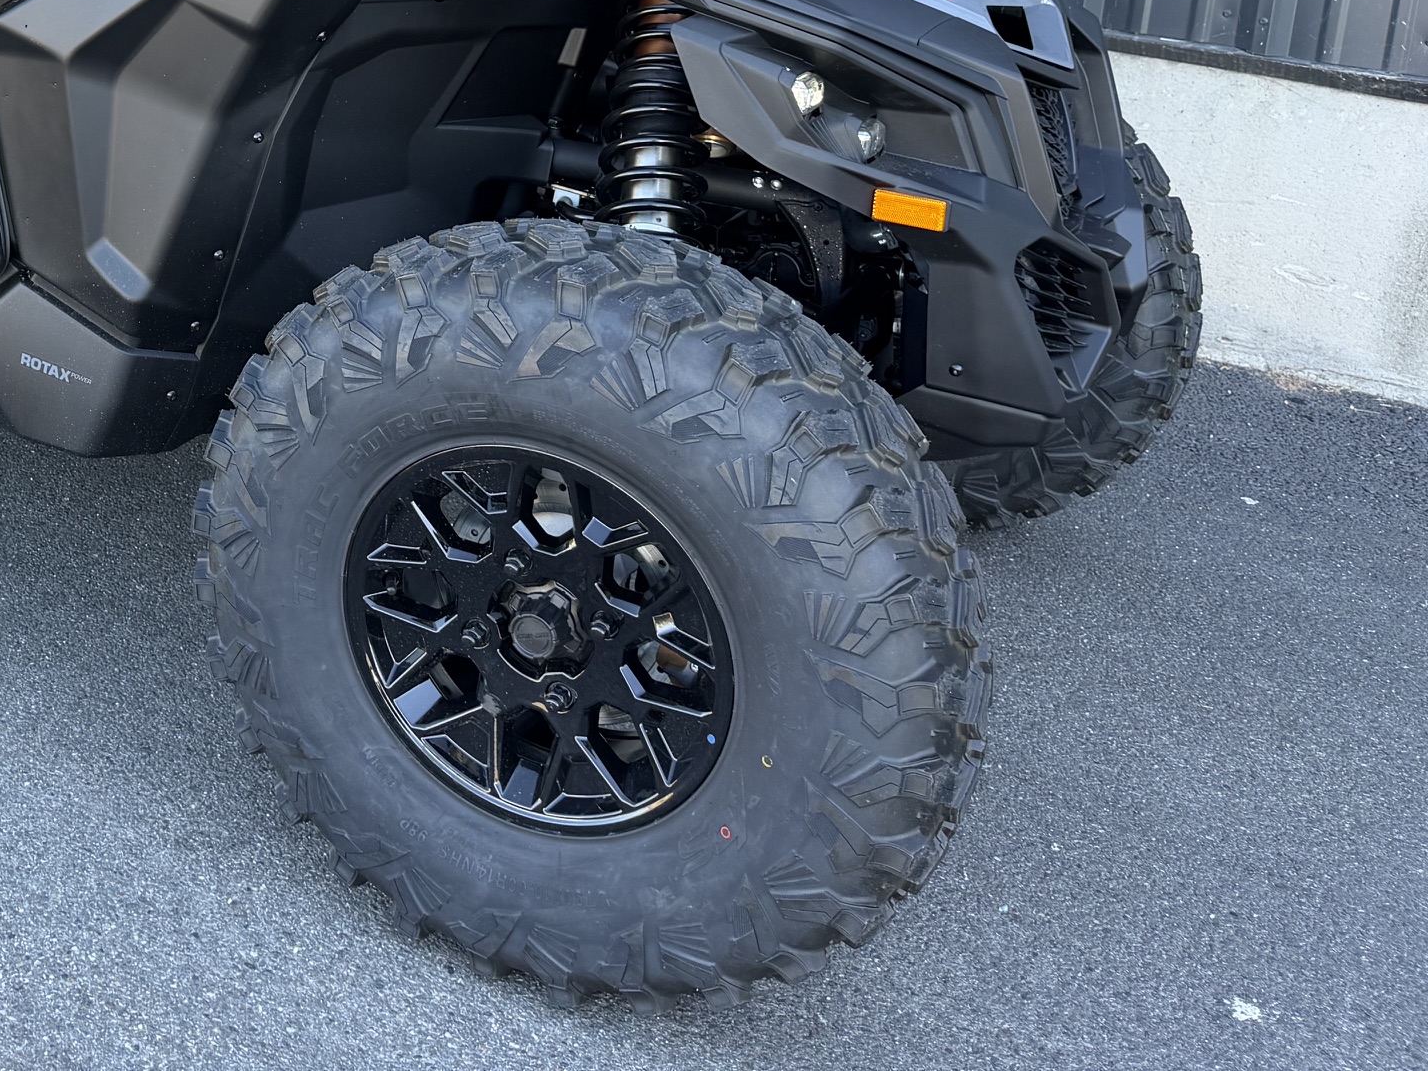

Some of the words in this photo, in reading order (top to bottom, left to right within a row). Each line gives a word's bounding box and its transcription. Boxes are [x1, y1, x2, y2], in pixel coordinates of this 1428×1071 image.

[20, 352, 71, 383] ROTAX
[71, 372, 92, 385] POWER
[334, 401, 489, 481] FORCE
